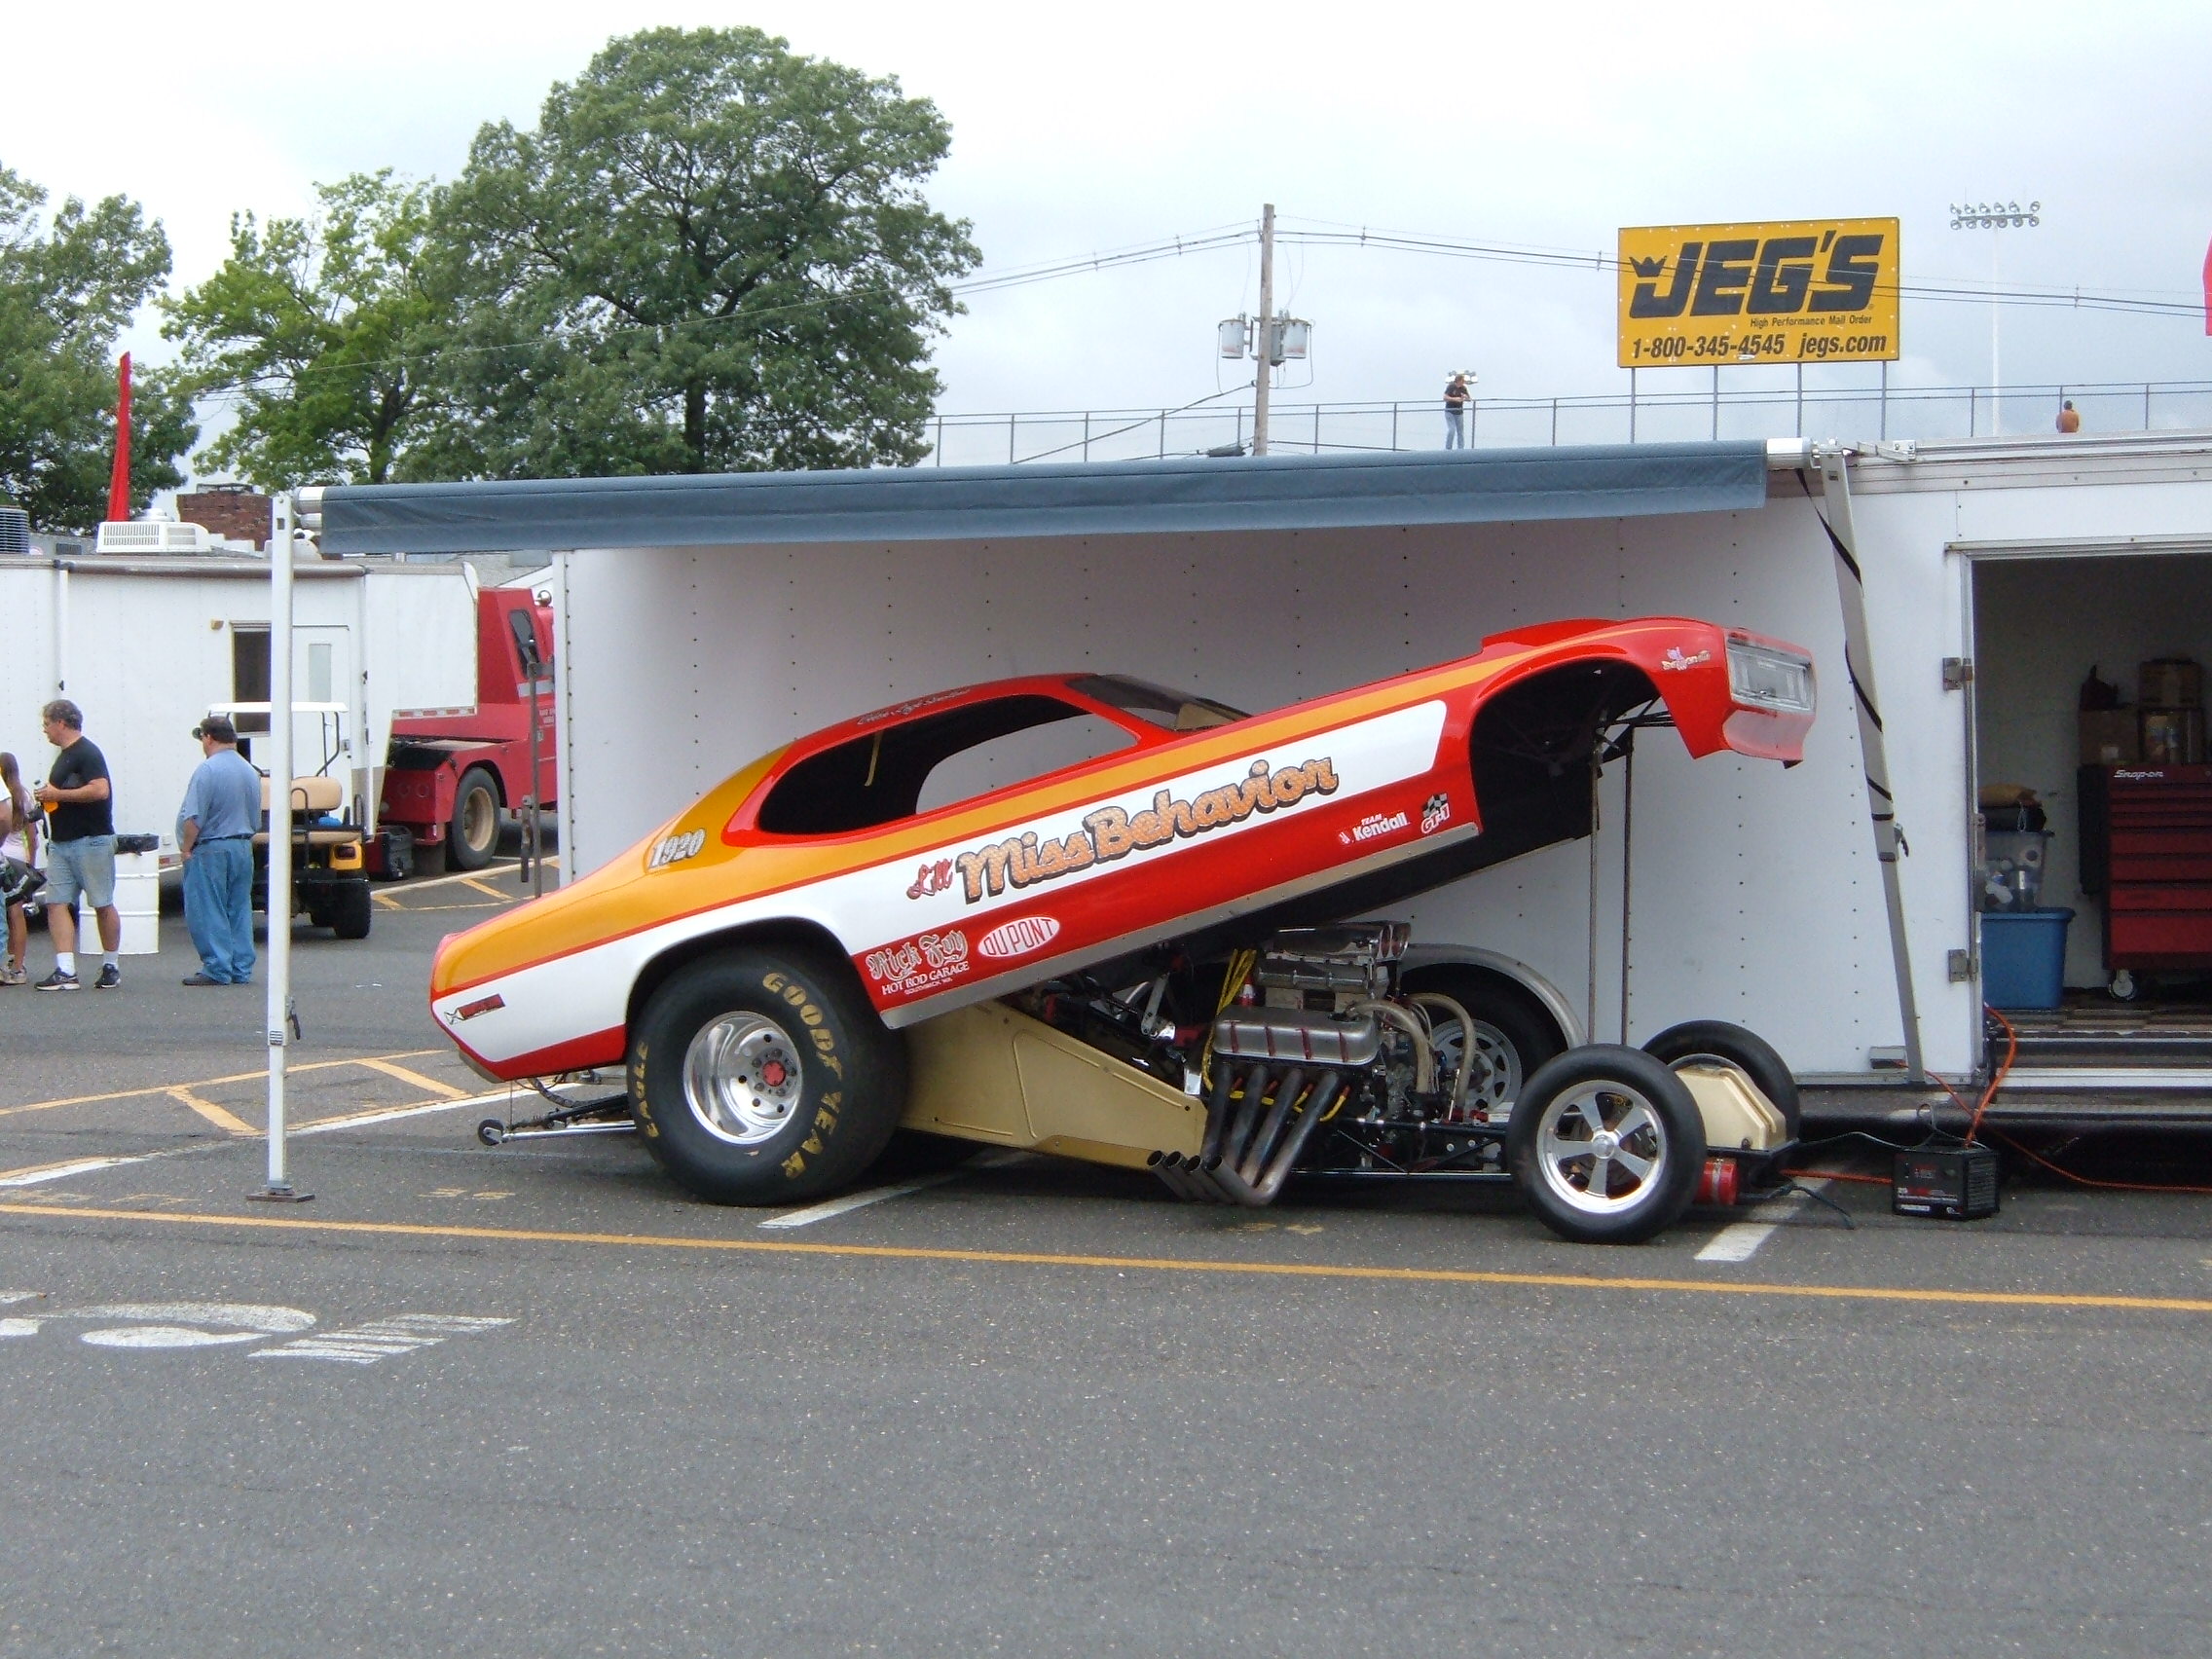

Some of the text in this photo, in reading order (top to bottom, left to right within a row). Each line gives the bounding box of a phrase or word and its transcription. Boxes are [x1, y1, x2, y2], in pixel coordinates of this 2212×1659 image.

[1629, 230, 1885, 319] JEG'S
[1751, 314, 1872, 329] High Performance Mail Order
[1632, 333, 1888, 359] 1-800-345-4545 jegs.com
[2114, 769, 2163, 781] Snap-on
[1352, 811, 1409, 841] Kendall
[648, 828, 706, 869] 1920
[881, 980, 904, 996] HOT
[905, 973, 928, 988] ROD
[929, 961, 971, 980] GARAGE
